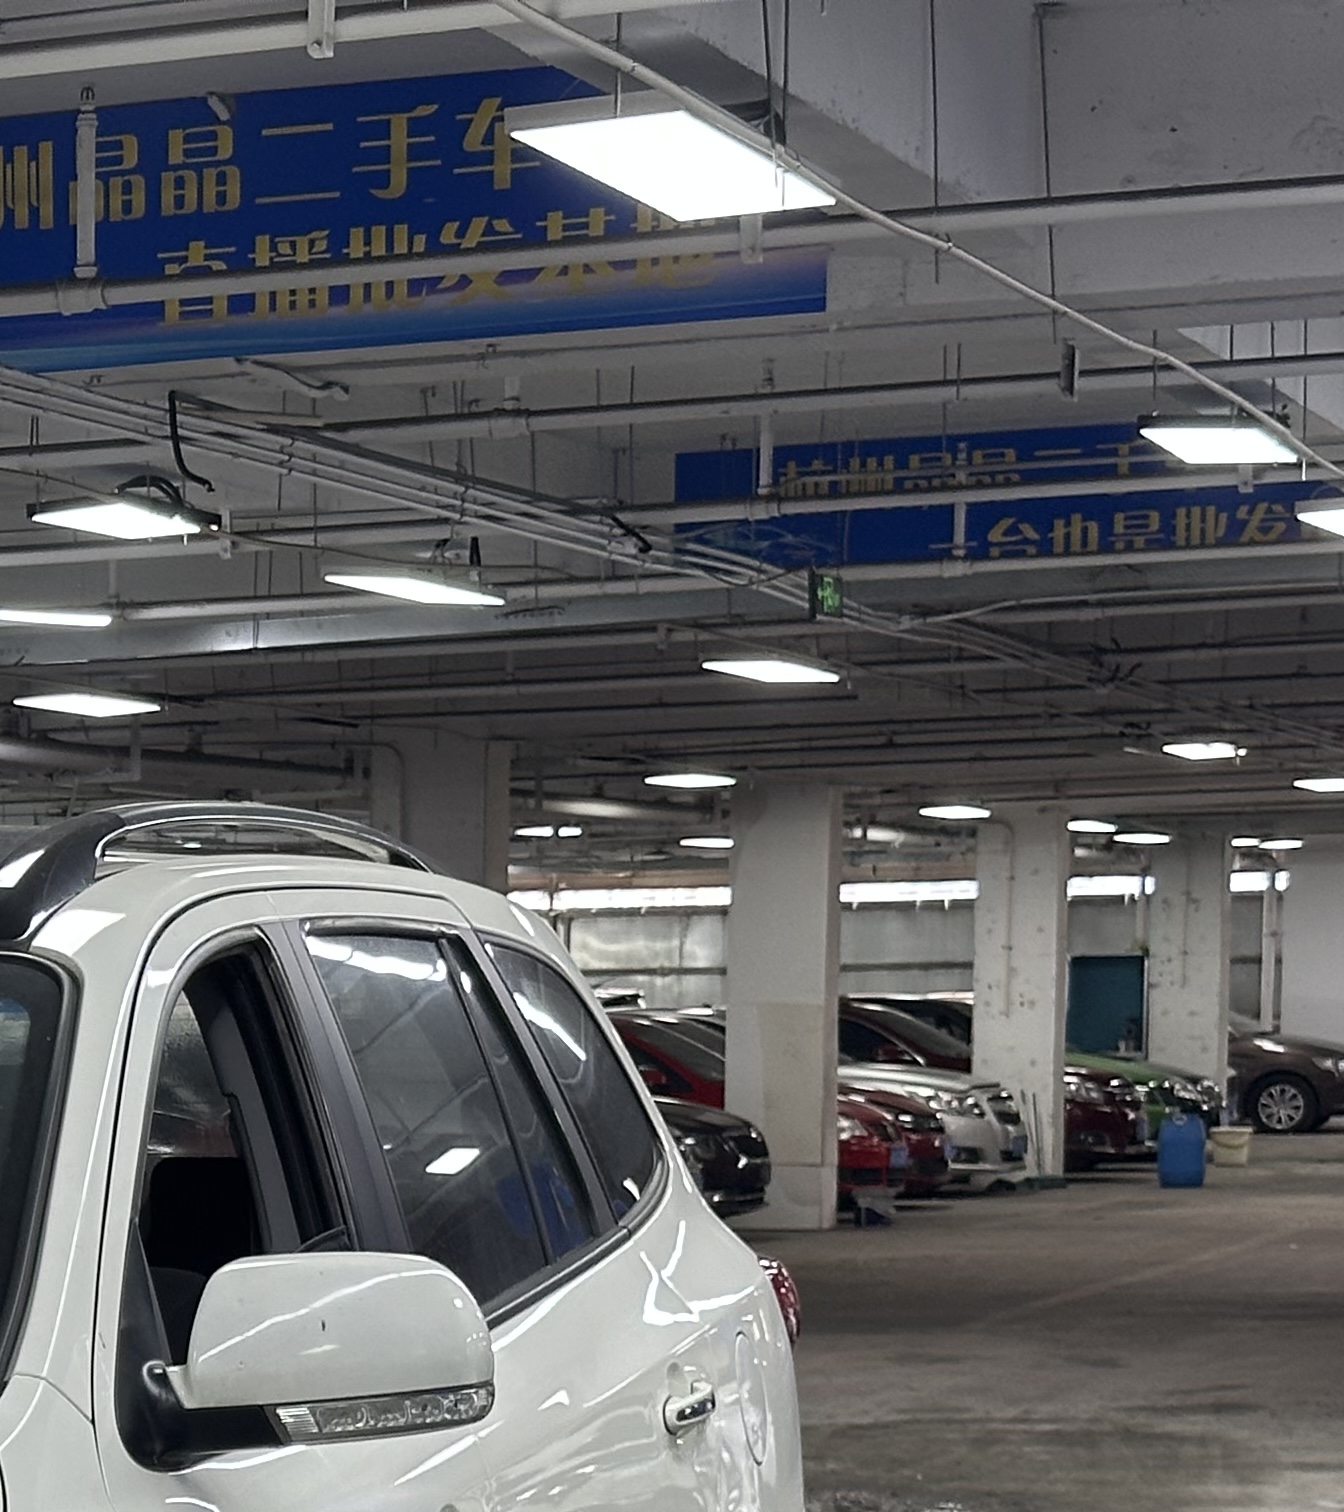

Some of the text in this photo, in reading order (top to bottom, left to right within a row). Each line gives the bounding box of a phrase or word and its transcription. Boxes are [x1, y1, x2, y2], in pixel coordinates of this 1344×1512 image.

[929, 501, 1312, 557] 一台也是批发
